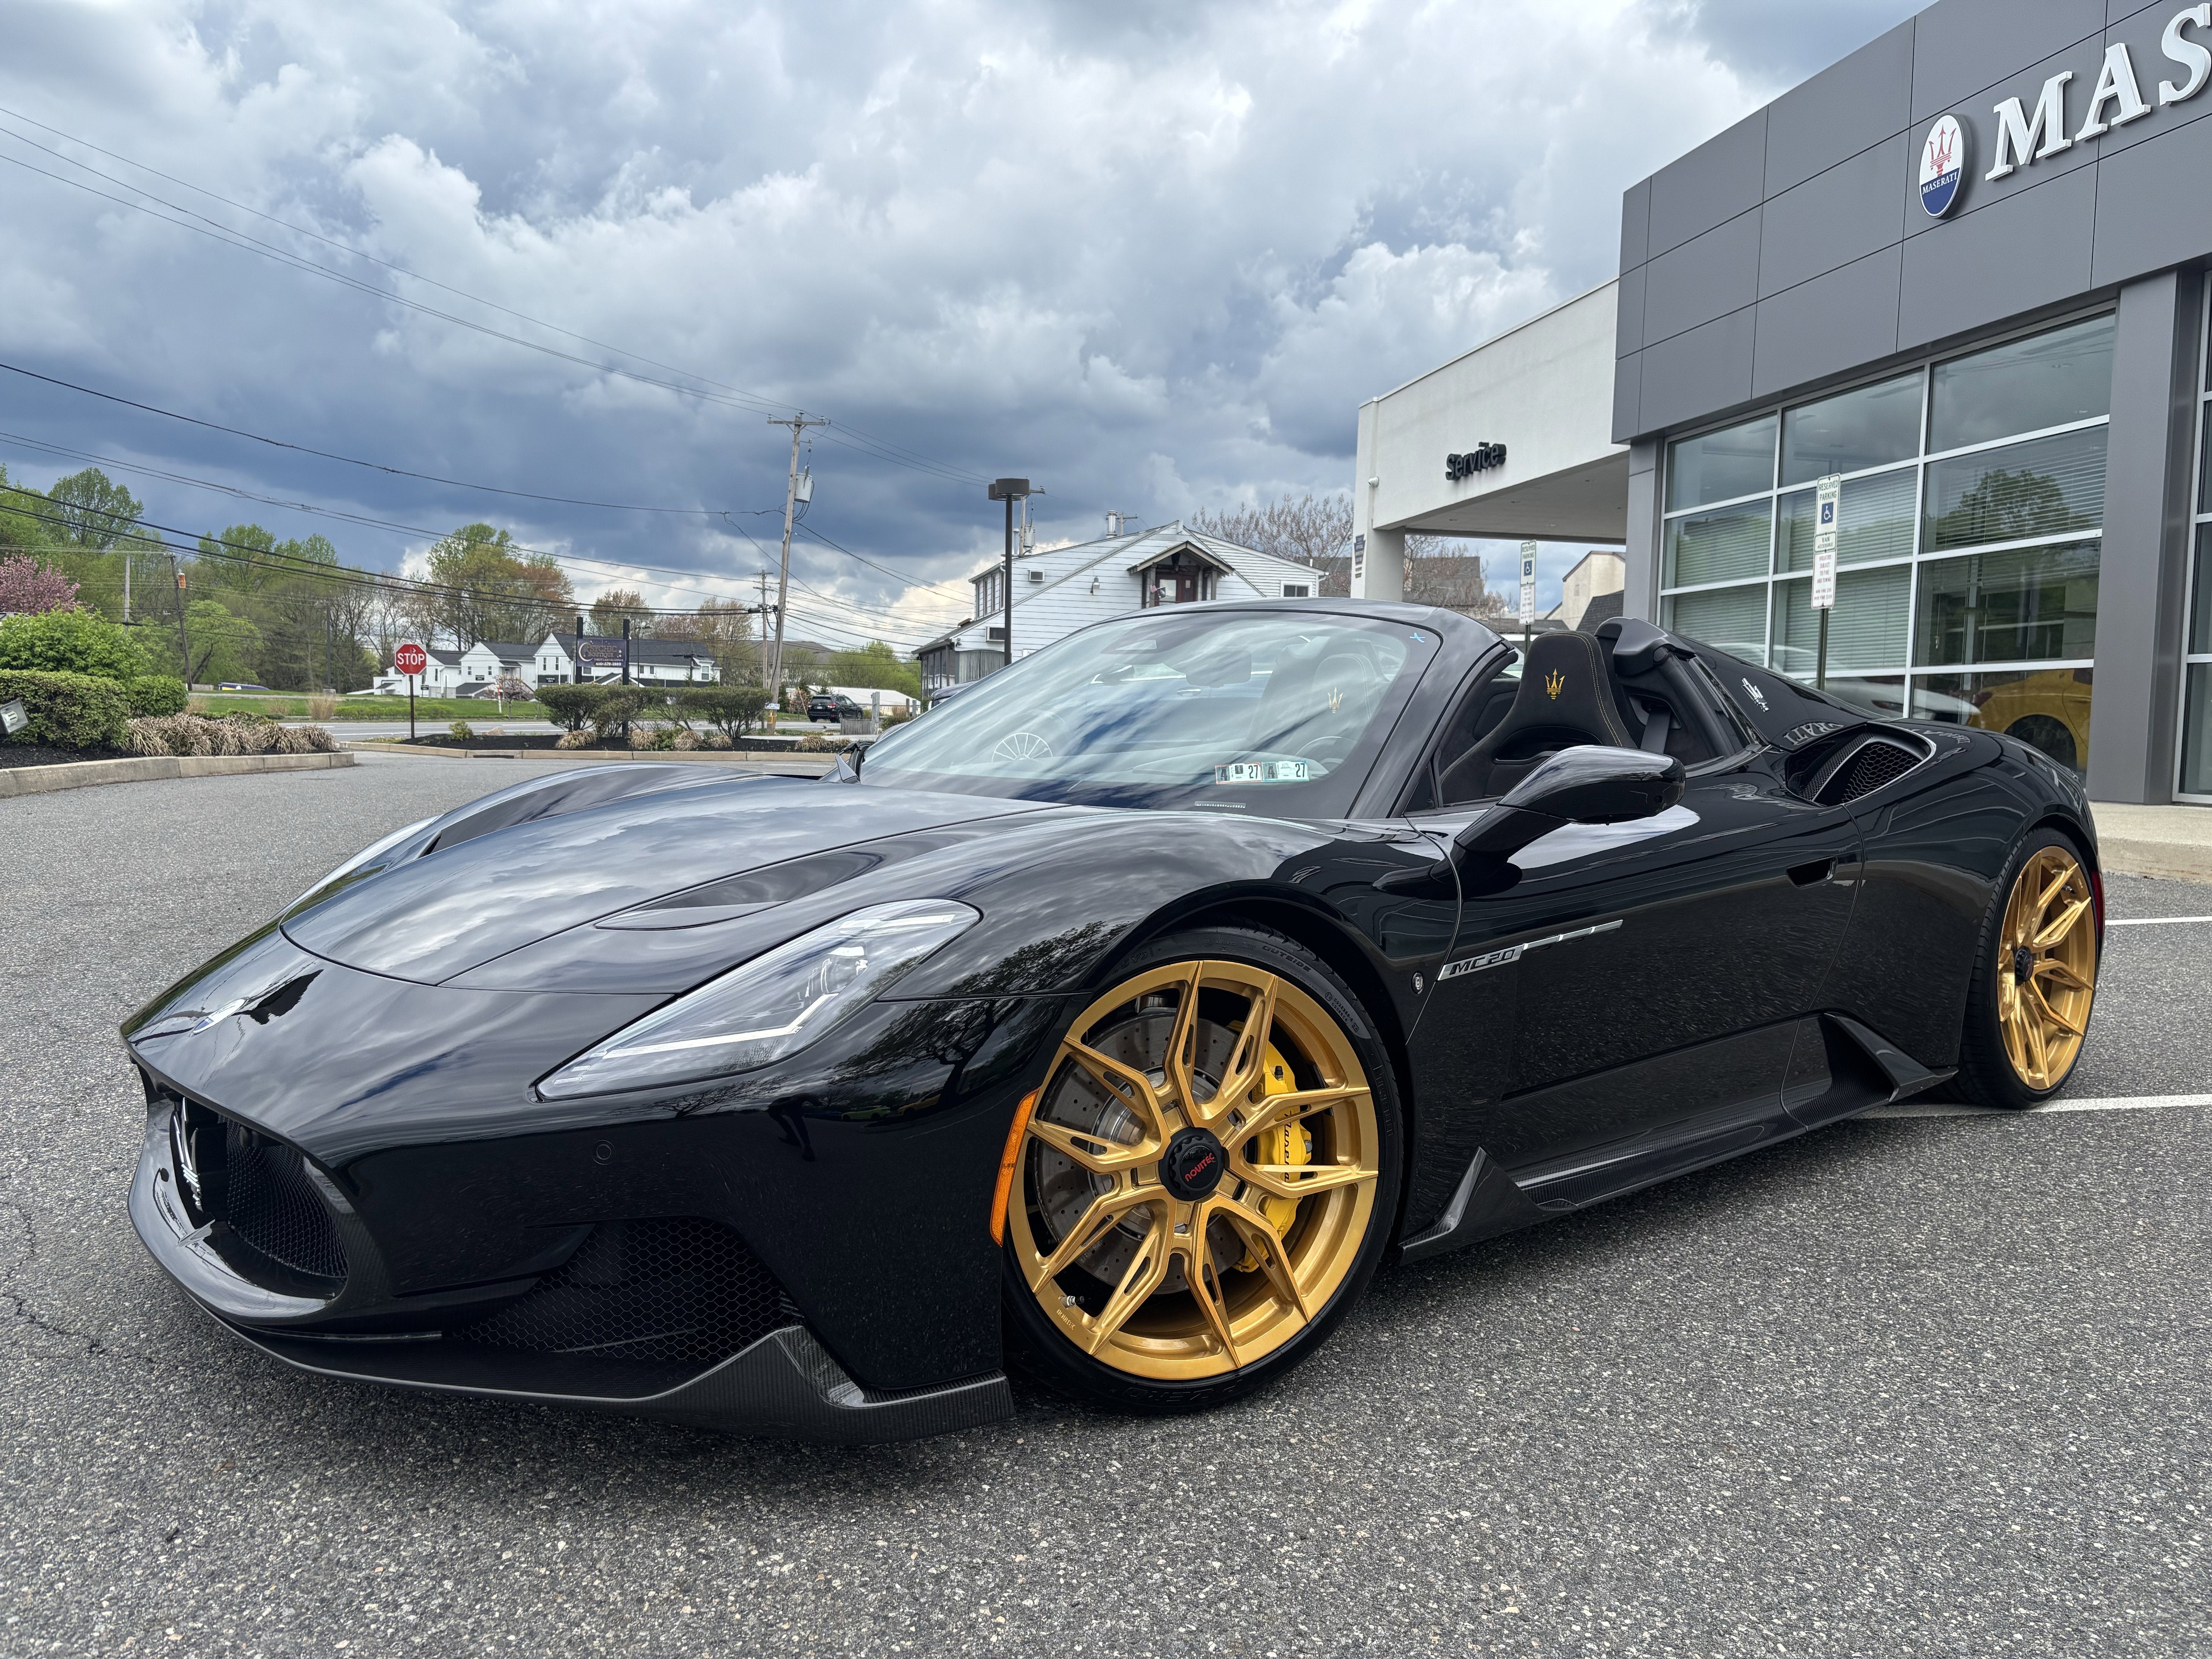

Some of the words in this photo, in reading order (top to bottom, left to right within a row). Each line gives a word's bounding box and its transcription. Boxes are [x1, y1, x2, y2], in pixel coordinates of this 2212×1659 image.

[1922, 172, 1958, 195] MASERATI
[1446, 442, 1506, 480] Service
[1819, 480, 1838, 491] RESERVED
[1820, 491, 1836, 501] PARKING
[586, 644, 617, 653] PSYCHIC
[397, 653, 425, 665] STOP
[1249, 765, 1258, 779] 27
[1295, 763, 1305, 778] 27
[1262, 945, 1311, 972] OUTSIDE
[1449, 949, 1516, 975] MC20
